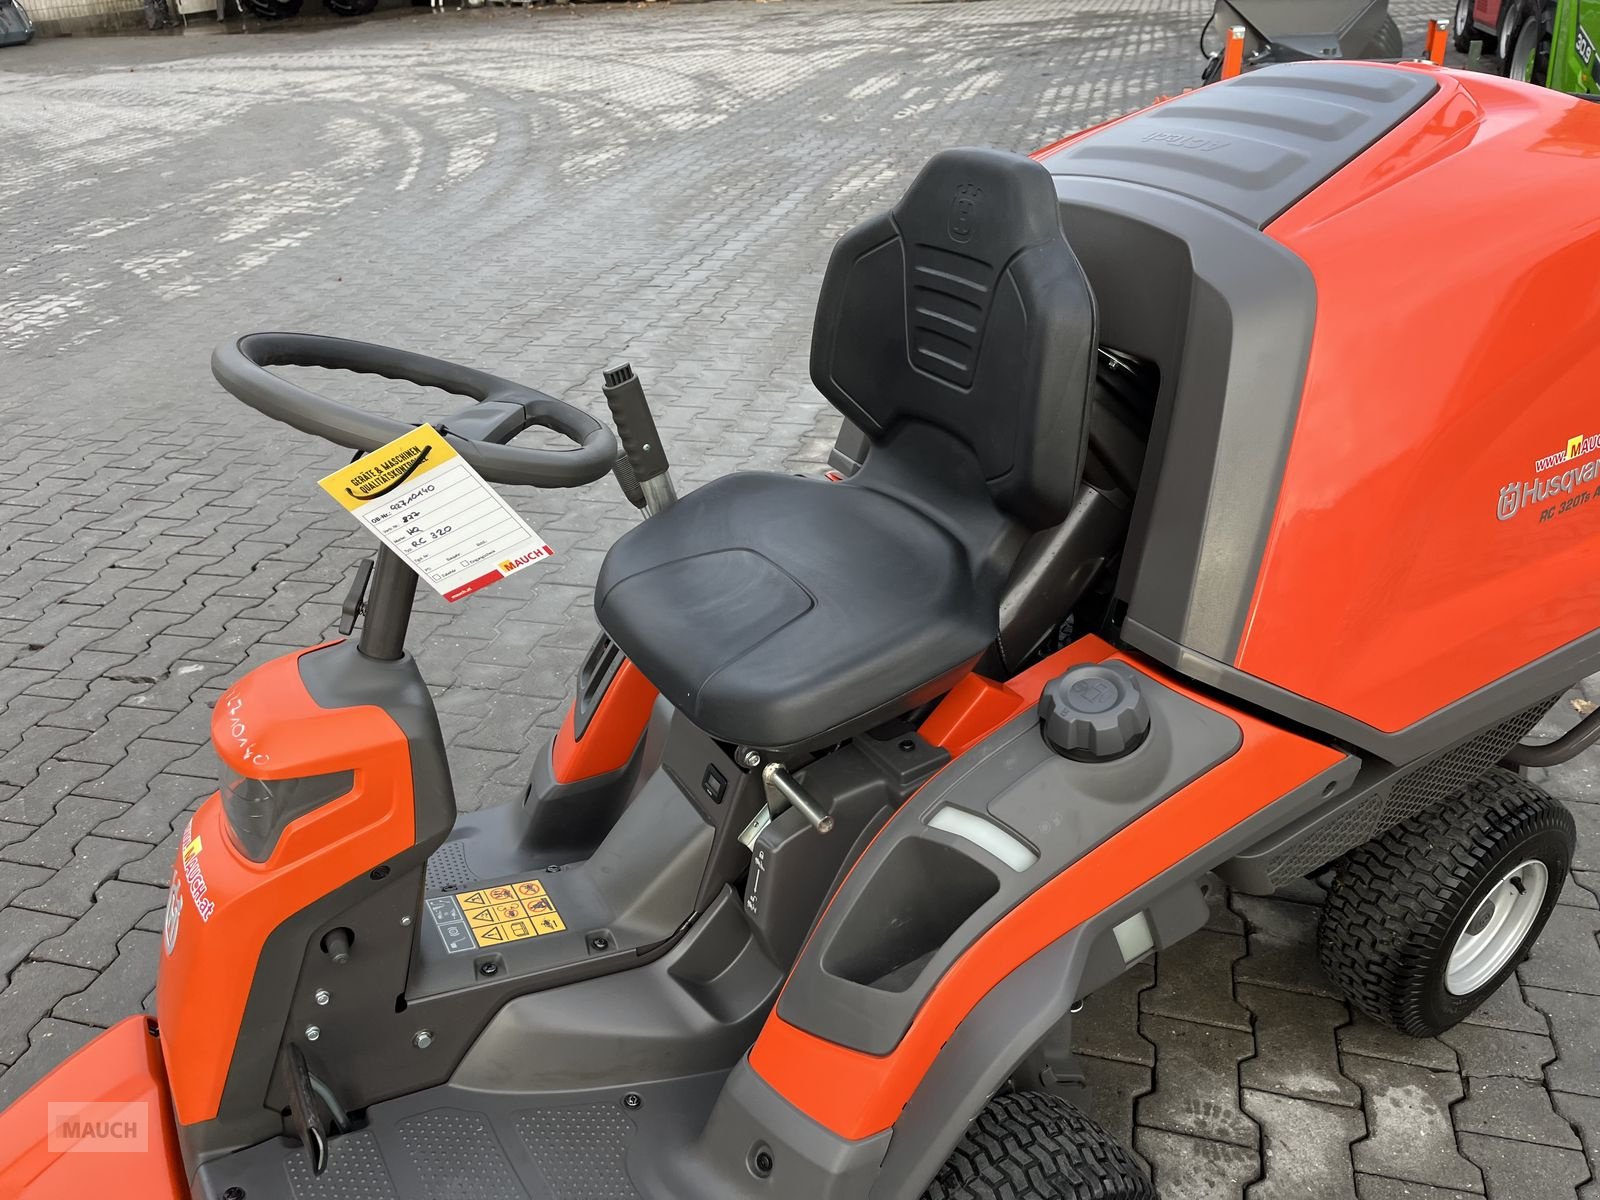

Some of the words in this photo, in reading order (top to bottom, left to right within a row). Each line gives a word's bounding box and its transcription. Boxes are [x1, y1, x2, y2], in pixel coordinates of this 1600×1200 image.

[1576, 34, 1592, 64] 30.9
[350, 468, 376, 487] GERÄTE
[374, 466, 383, 476] &
[381, 445, 421, 471] MASCHINEN
[359, 457, 428, 494] QUALITÄTSKONTR
[390, 484, 435, 510] 92710140
[1540, 506, 1556, 522] RC
[1559, 490, 1591, 514] 320Ts
[406, 526, 424, 536] HQ
[411, 537, 427, 547] RC
[430, 525, 452, 539] 320
[504, 548, 544, 571] MAUCH
